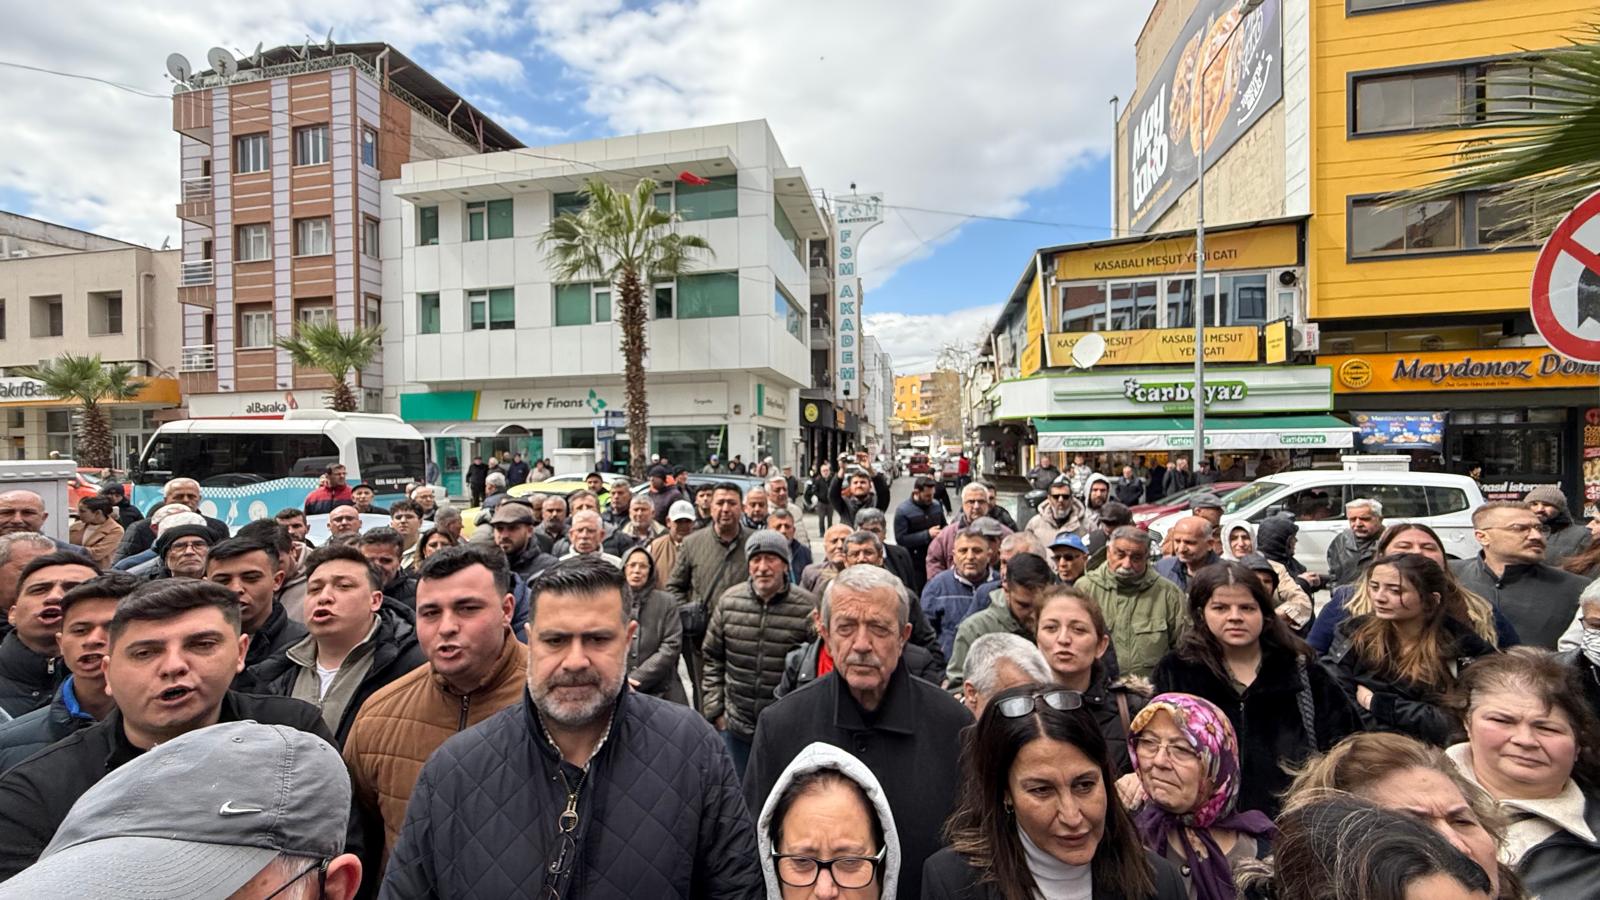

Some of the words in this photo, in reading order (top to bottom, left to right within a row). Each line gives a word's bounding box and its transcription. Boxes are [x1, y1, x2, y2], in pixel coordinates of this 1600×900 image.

[839, 230, 854, 275] FSM
[1094, 257, 1144, 271] KASABALI
[1147, 254, 1183, 267] MESUT
[1210, 332, 1243, 343] MESUT
[1102, 350, 1117, 358] ATI
[1203, 346, 1225, 358] ÇATI
[1392, 356, 1534, 384] Maydonoz
[246, 401, 287, 413] alBaraka
[503, 398, 544, 412] Türkiye
[546, 397, 584, 408] Finans
